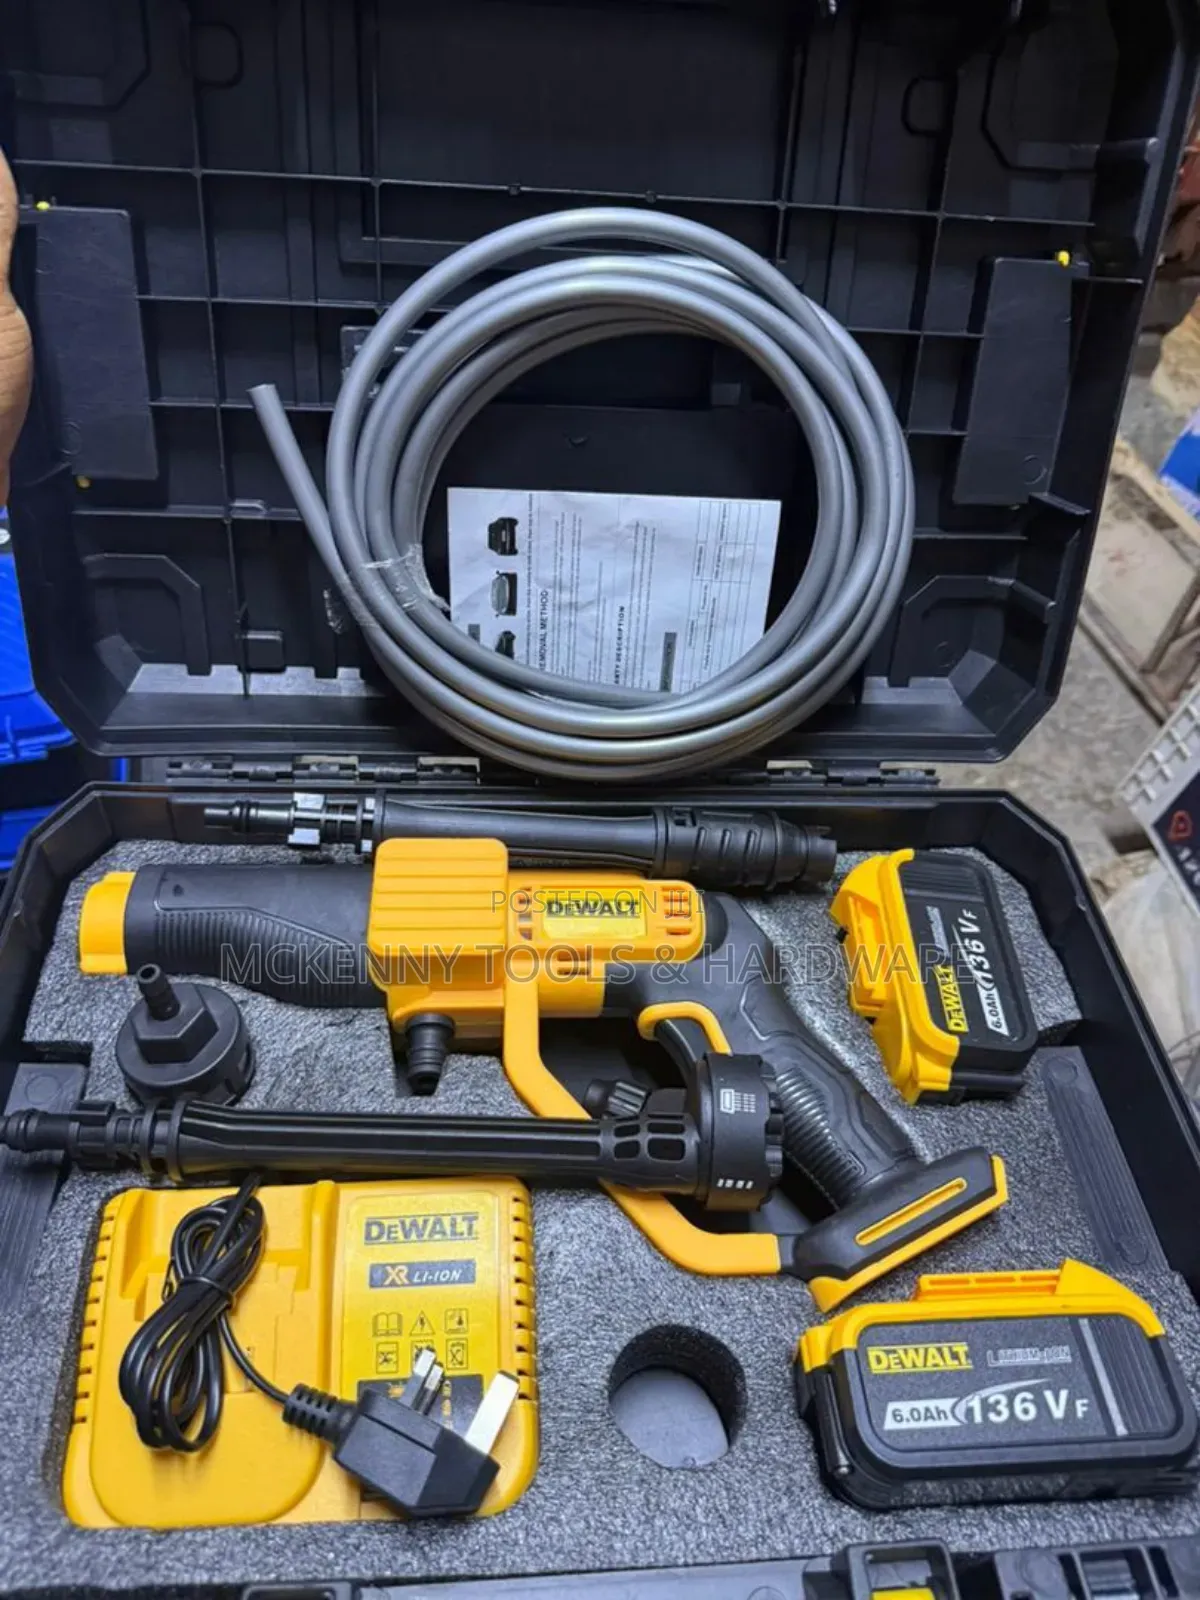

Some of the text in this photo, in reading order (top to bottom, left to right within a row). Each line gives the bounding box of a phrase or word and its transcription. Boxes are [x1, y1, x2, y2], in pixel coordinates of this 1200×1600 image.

[540, 590, 548, 630] METHOD
[615, 605, 625, 662] DESCRIPTION
[547, 900, 638, 917] DEWALT
[966, 938, 995, 989] 136
[936, 966, 967, 1030] DEWALT
[985, 992, 1003, 1029] 6.0Ah
[364, 1214, 479, 1243] DEWALT
[384, 1265, 462, 1286] XR LI-ION
[868, 1346, 972, 1372] DEWALT
[891, 1405, 949, 1424] 6.0Ah
[967, 1391, 1037, 1424] 136
